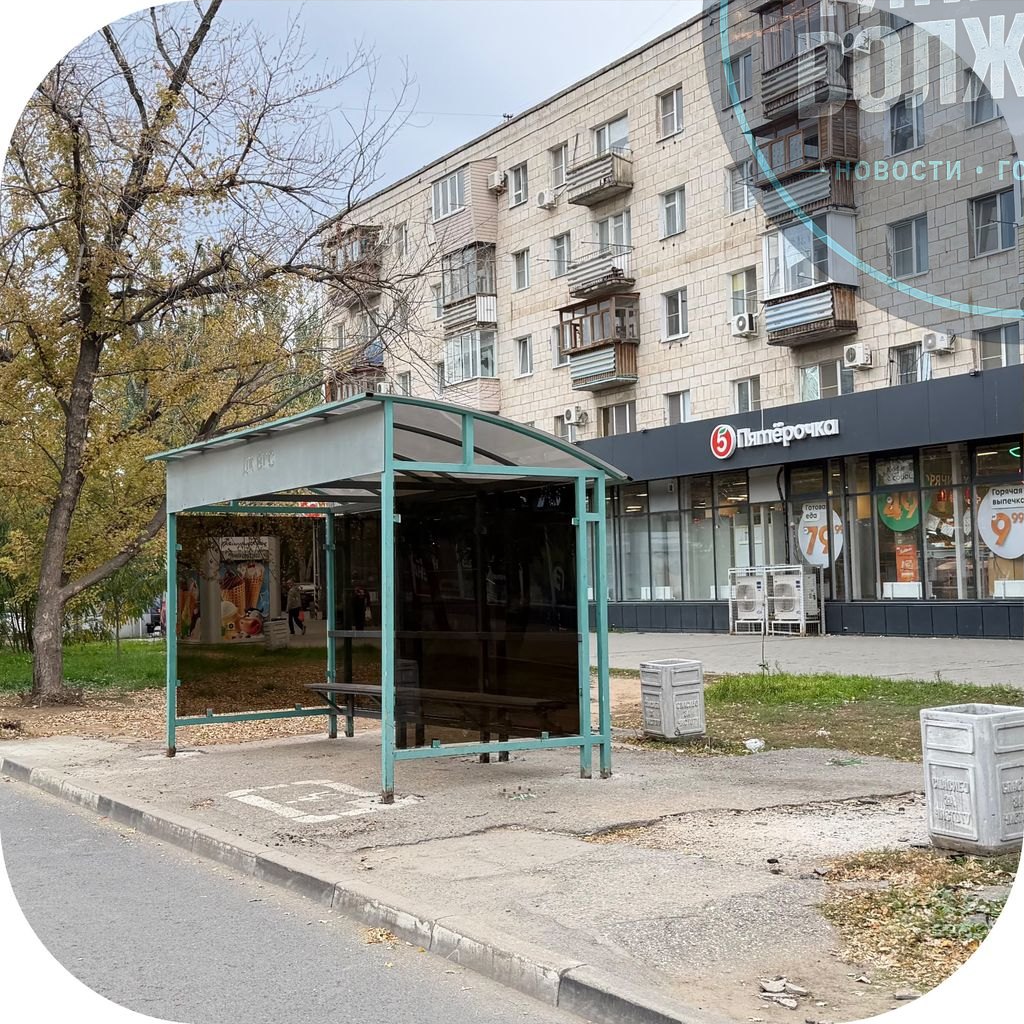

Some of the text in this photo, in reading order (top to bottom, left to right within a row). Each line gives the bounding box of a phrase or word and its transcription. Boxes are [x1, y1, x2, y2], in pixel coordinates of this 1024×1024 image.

[737, 419, 839, 447] Пятёрочка
[992, 488, 1023, 496] Горячая
[805, 526, 828, 555] 79
[991, 512, 1011, 546] 9
